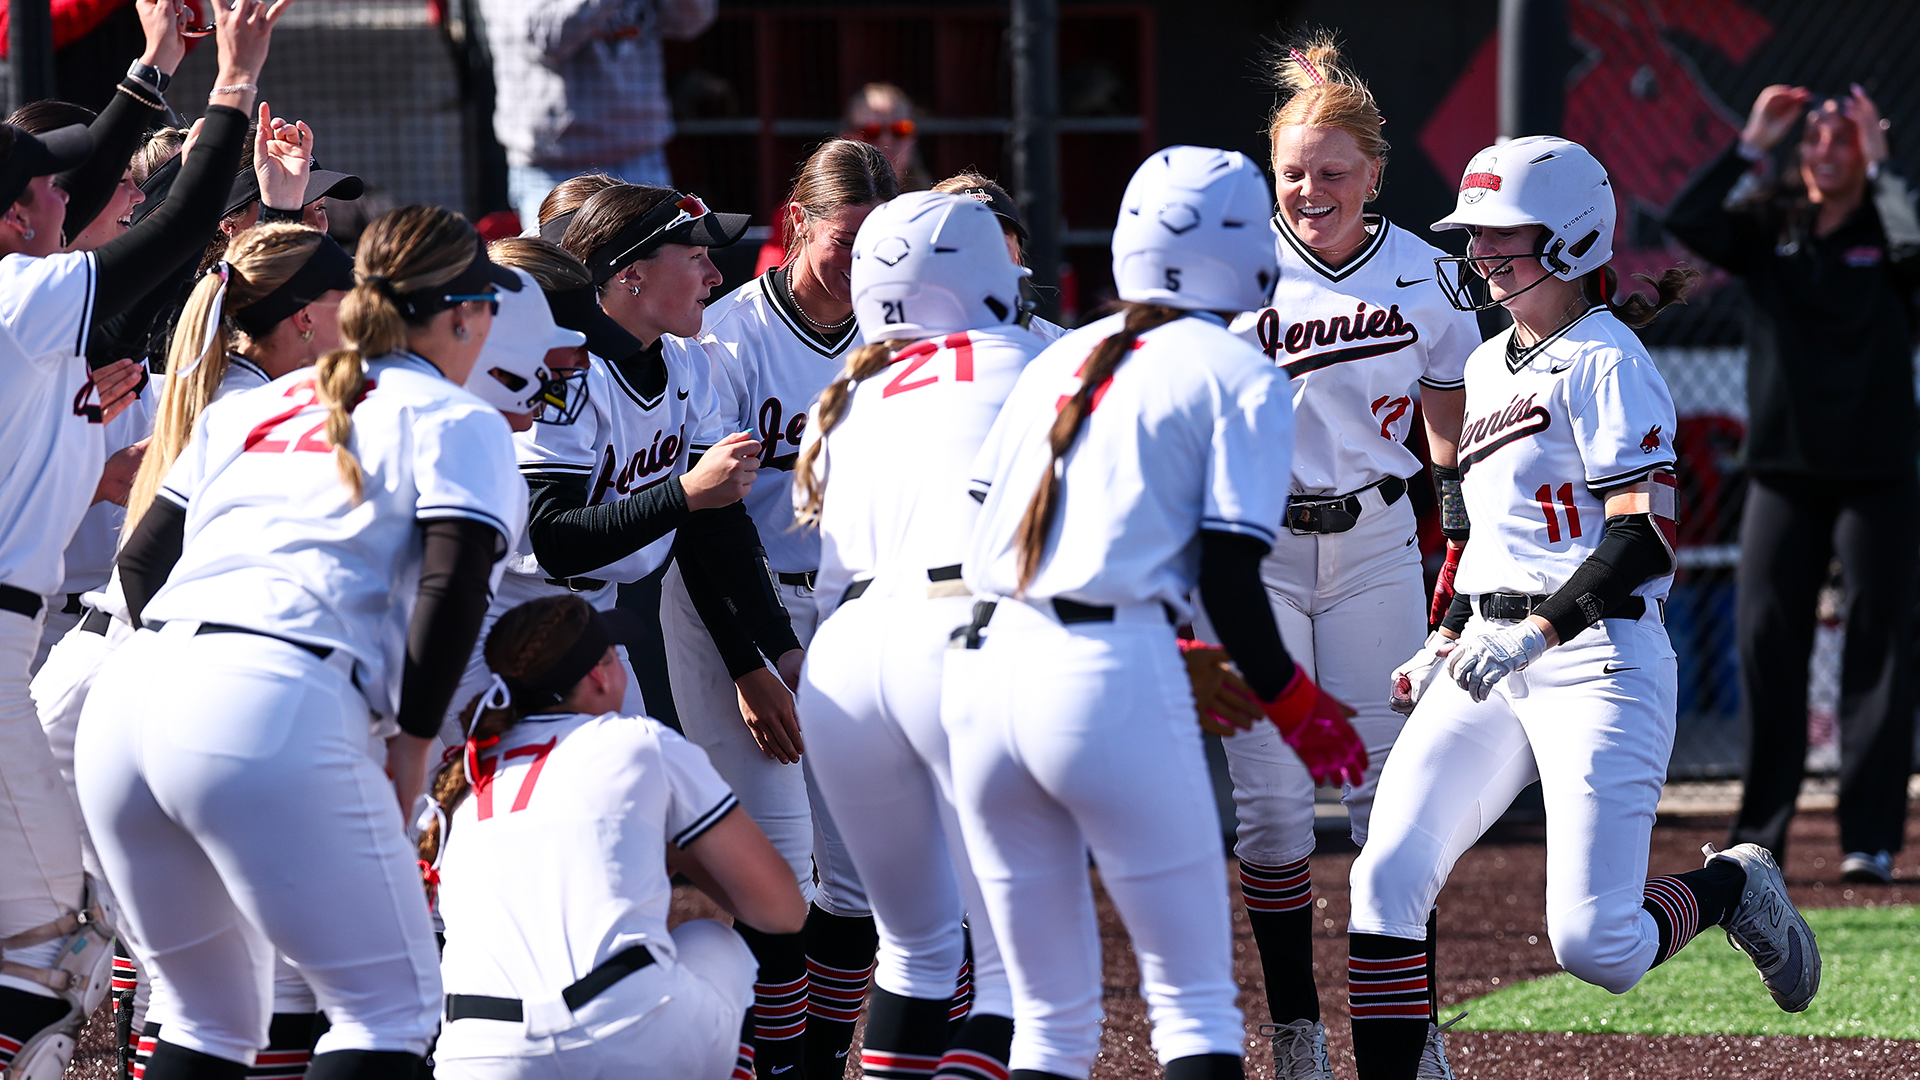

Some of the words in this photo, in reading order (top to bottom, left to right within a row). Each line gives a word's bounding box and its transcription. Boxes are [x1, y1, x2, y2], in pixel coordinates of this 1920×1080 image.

[1165, 267, 1181, 292] 5
[882, 299, 905, 325] 21
[1257, 302, 1410, 365] Jennies
[882, 331, 974, 399] 21
[1459, 392, 1542, 454] ennies
[1535, 482, 1582, 544] 11
[477, 734, 558, 822] 17
